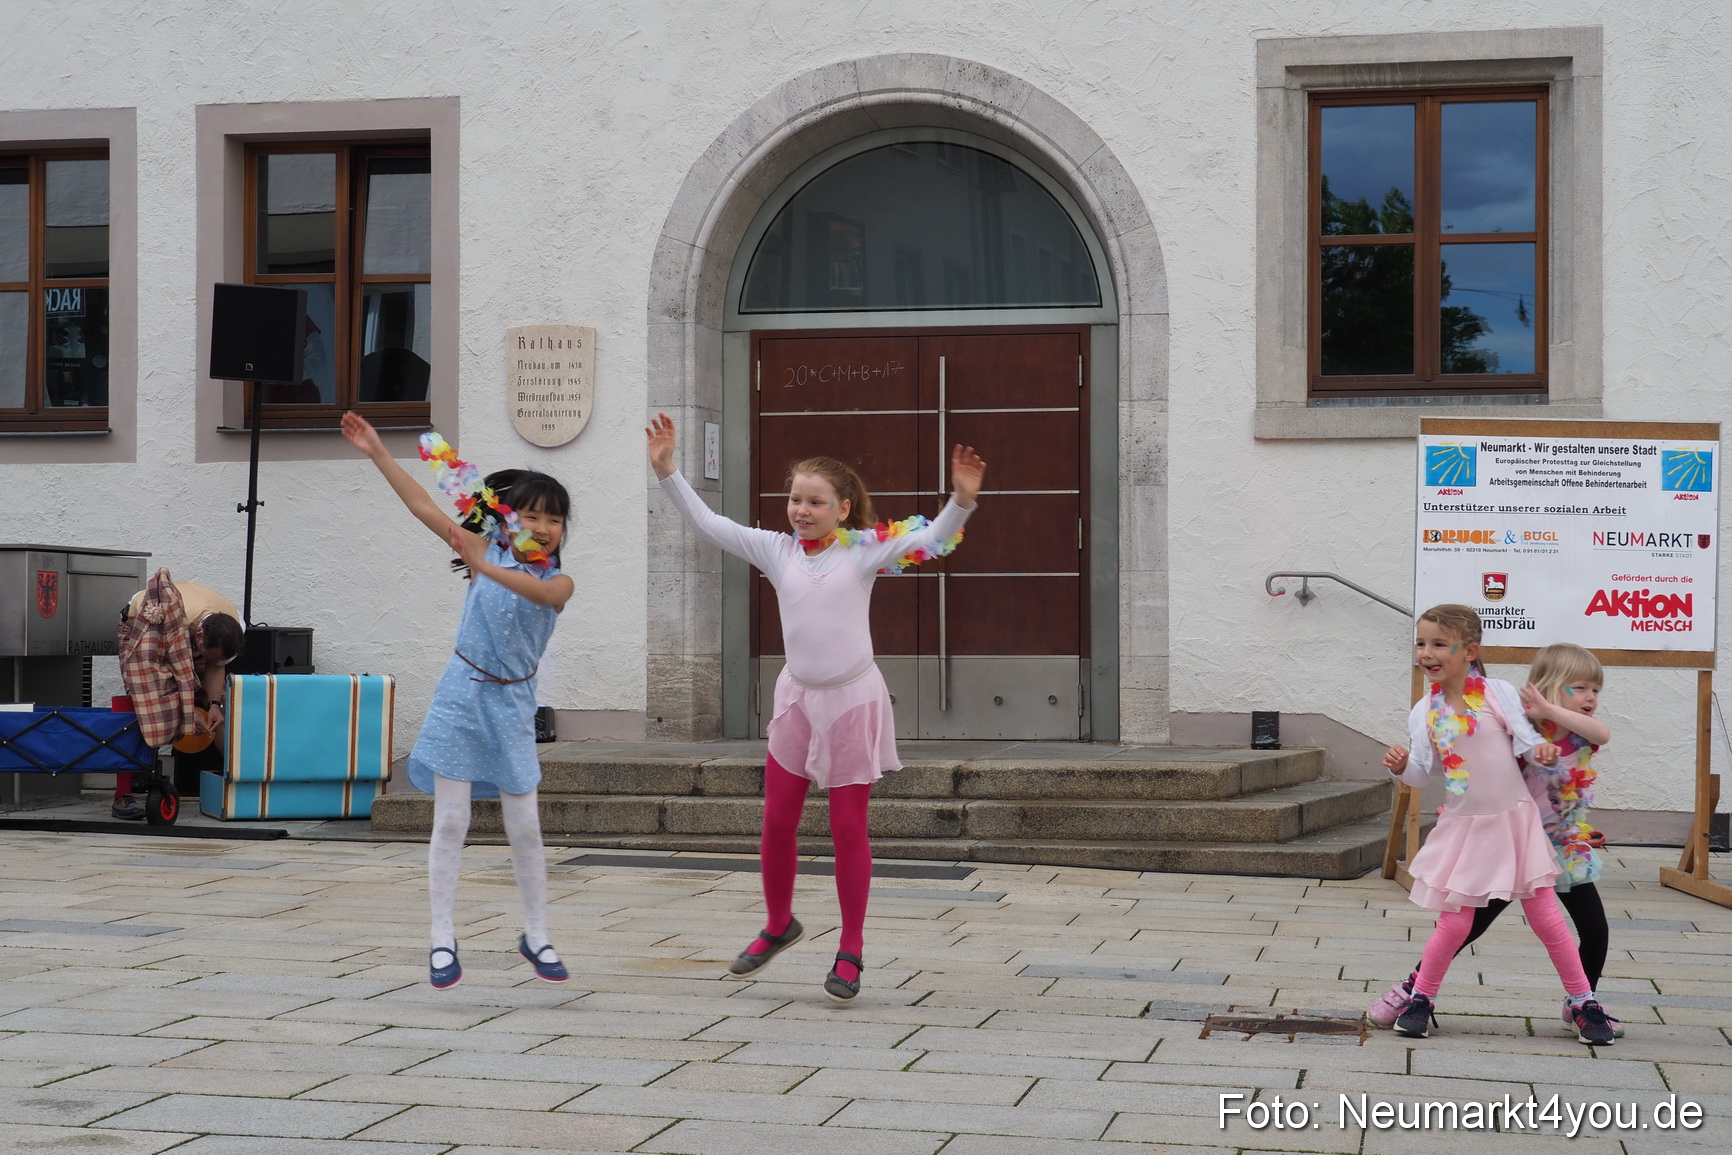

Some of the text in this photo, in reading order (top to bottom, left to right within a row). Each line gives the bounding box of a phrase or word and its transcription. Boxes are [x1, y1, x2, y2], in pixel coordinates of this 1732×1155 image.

[518, 336, 582, 350] Rathaus
[517, 360, 546, 370] Neubau
[550, 362, 561, 370] um
[517, 392, 565, 403] Wiederaufbau
[517, 408, 582, 419] Generalsanierung
[541, 423, 556, 431] 1999
[1480, 441, 1526, 453] Neumarkt
[1534, 442, 1550, 453] Wir
[1552, 443, 1596, 456] gestalten
[1598, 445, 1630, 454] unsere
[1632, 444, 1657, 455] Stadt
[1495, 457, 1541, 466] Europäischer
[1542, 458, 1579, 467] Protesttag
[1592, 459, 1642, 468] Gleichstellung
[1529, 468, 1564, 476] Menschen
[1578, 469, 1622, 478] Behinderung
[1489, 477, 1648, 489] Arbeitsgemeinschaft Offene Behindertenarbeit
[1423, 503, 1627, 515] Unterstützer unserer sozialen Arbeit
[1504, 529, 1518, 545] &
[1523, 531, 1559, 541] BÖGL
[1593, 531, 1693, 548] NEUMARKT
[1611, 574, 1652, 582] Gefördert
[1654, 575, 1678, 583] durch
[1483, 617, 1535, 630] msbräu
[1630, 620, 1693, 632] MENSCH
[68, 640, 120, 654] RATHAUSPL
